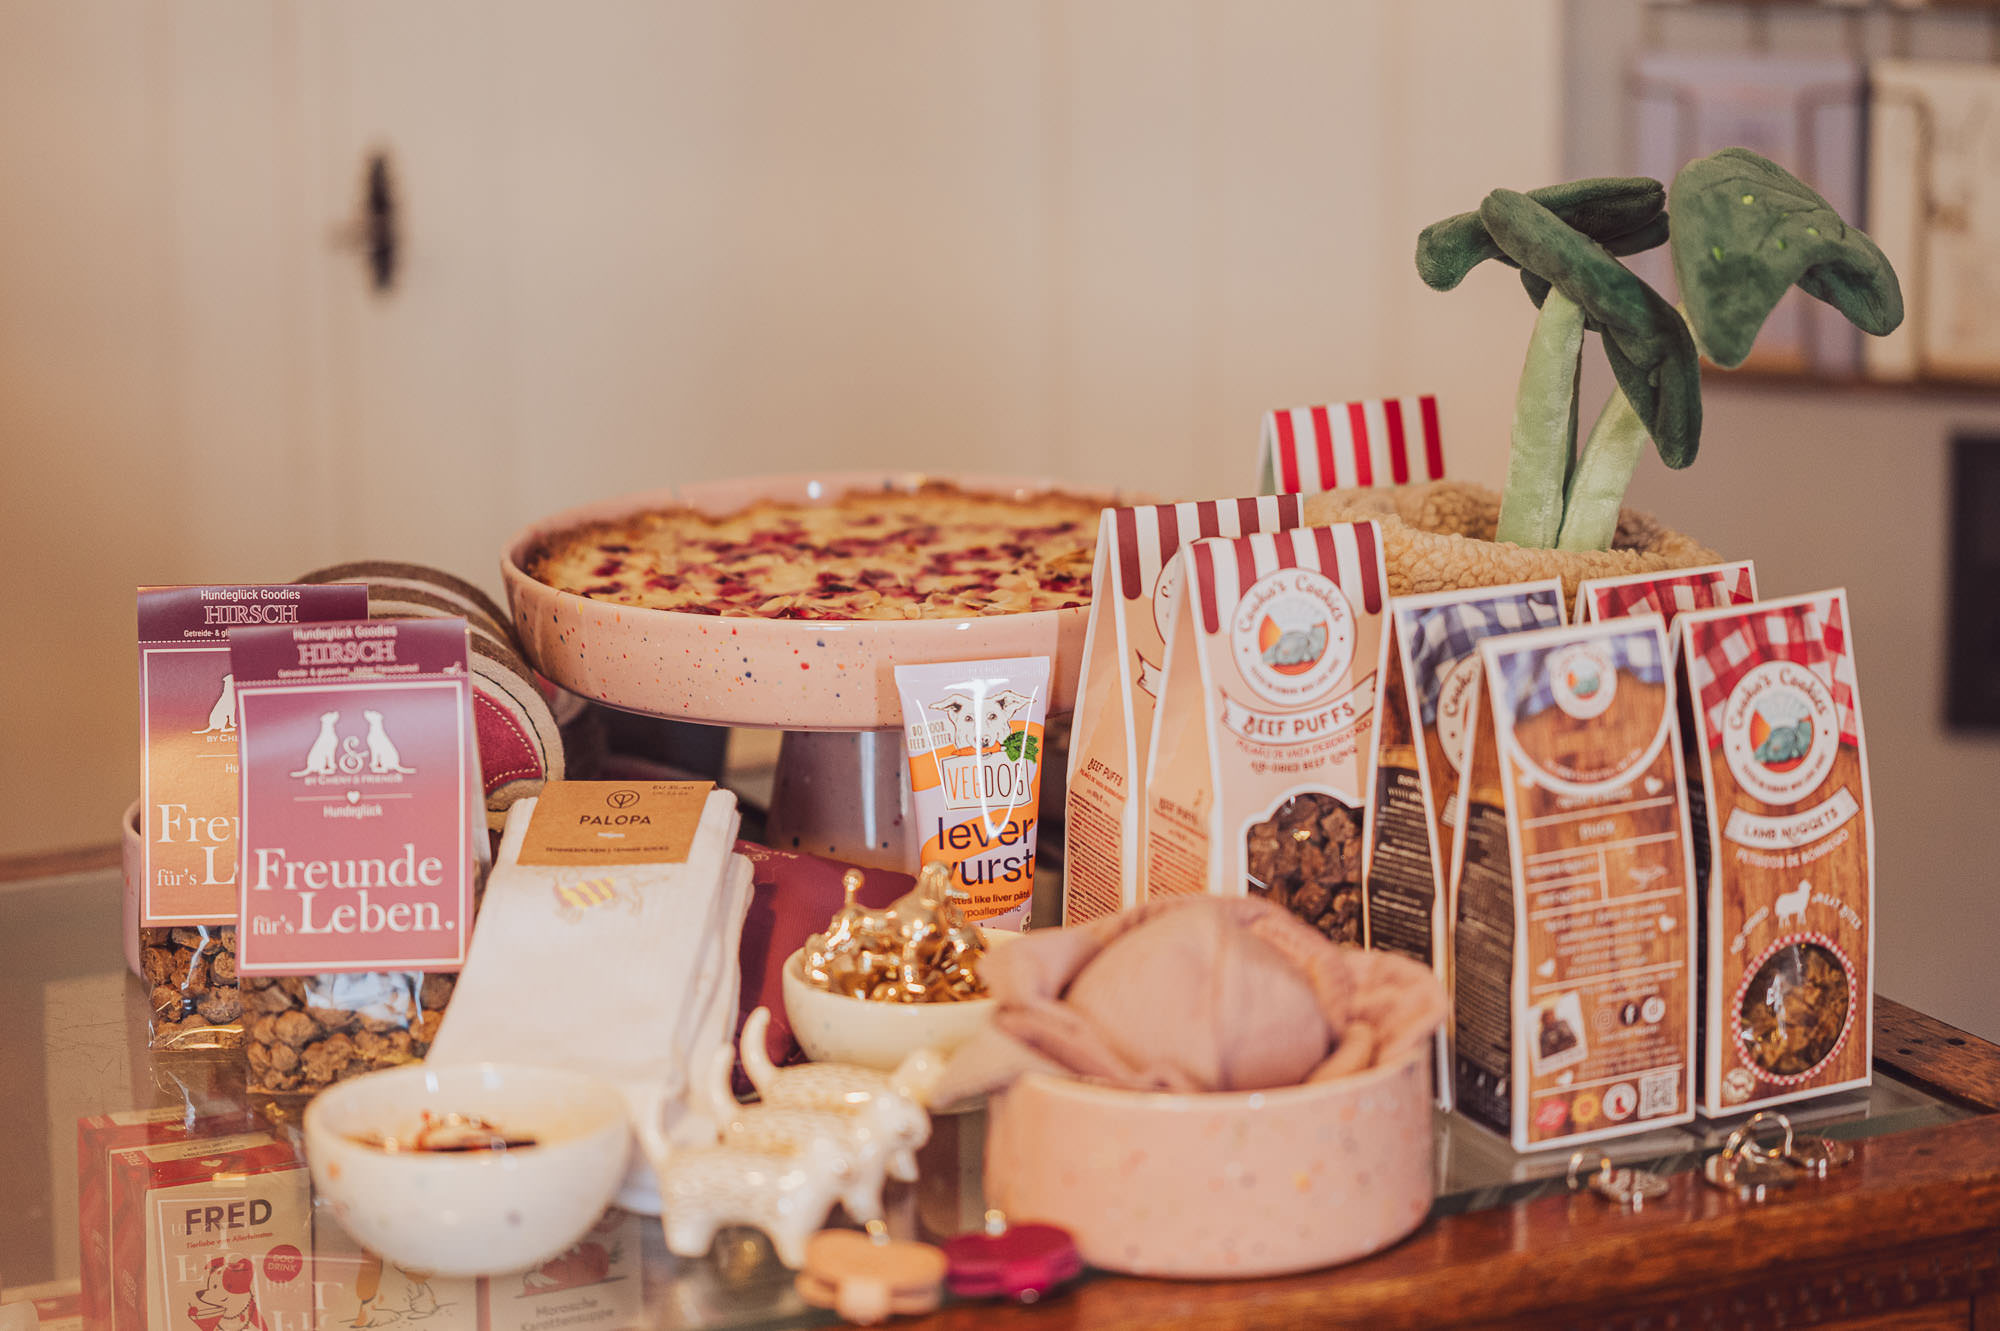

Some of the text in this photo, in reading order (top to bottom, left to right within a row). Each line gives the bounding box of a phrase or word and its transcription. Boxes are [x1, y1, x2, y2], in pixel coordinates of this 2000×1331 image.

[200, 589, 301, 602] Hundeglück Goodies
[204, 604, 299, 625] HIRSCH
[297, 639, 397, 665] HIRSCH
[1244, 702, 1355, 737] BEEF PUFFS
[947, 762, 1024, 800] VEGDOG
[579, 815, 651, 825] PALOPA
[156, 868, 197, 887] für's
[253, 843, 443, 891] Freunde
[952, 849, 1033, 886] urst
[974, 895, 991, 904] like
[992, 893, 1012, 903] liver
[252, 890, 456, 936] für's Leben.
[965, 904, 1022, 917] poallergenic
[185, 1198, 272, 1236] FRED
[267, 1262, 297, 1273] DRINK
